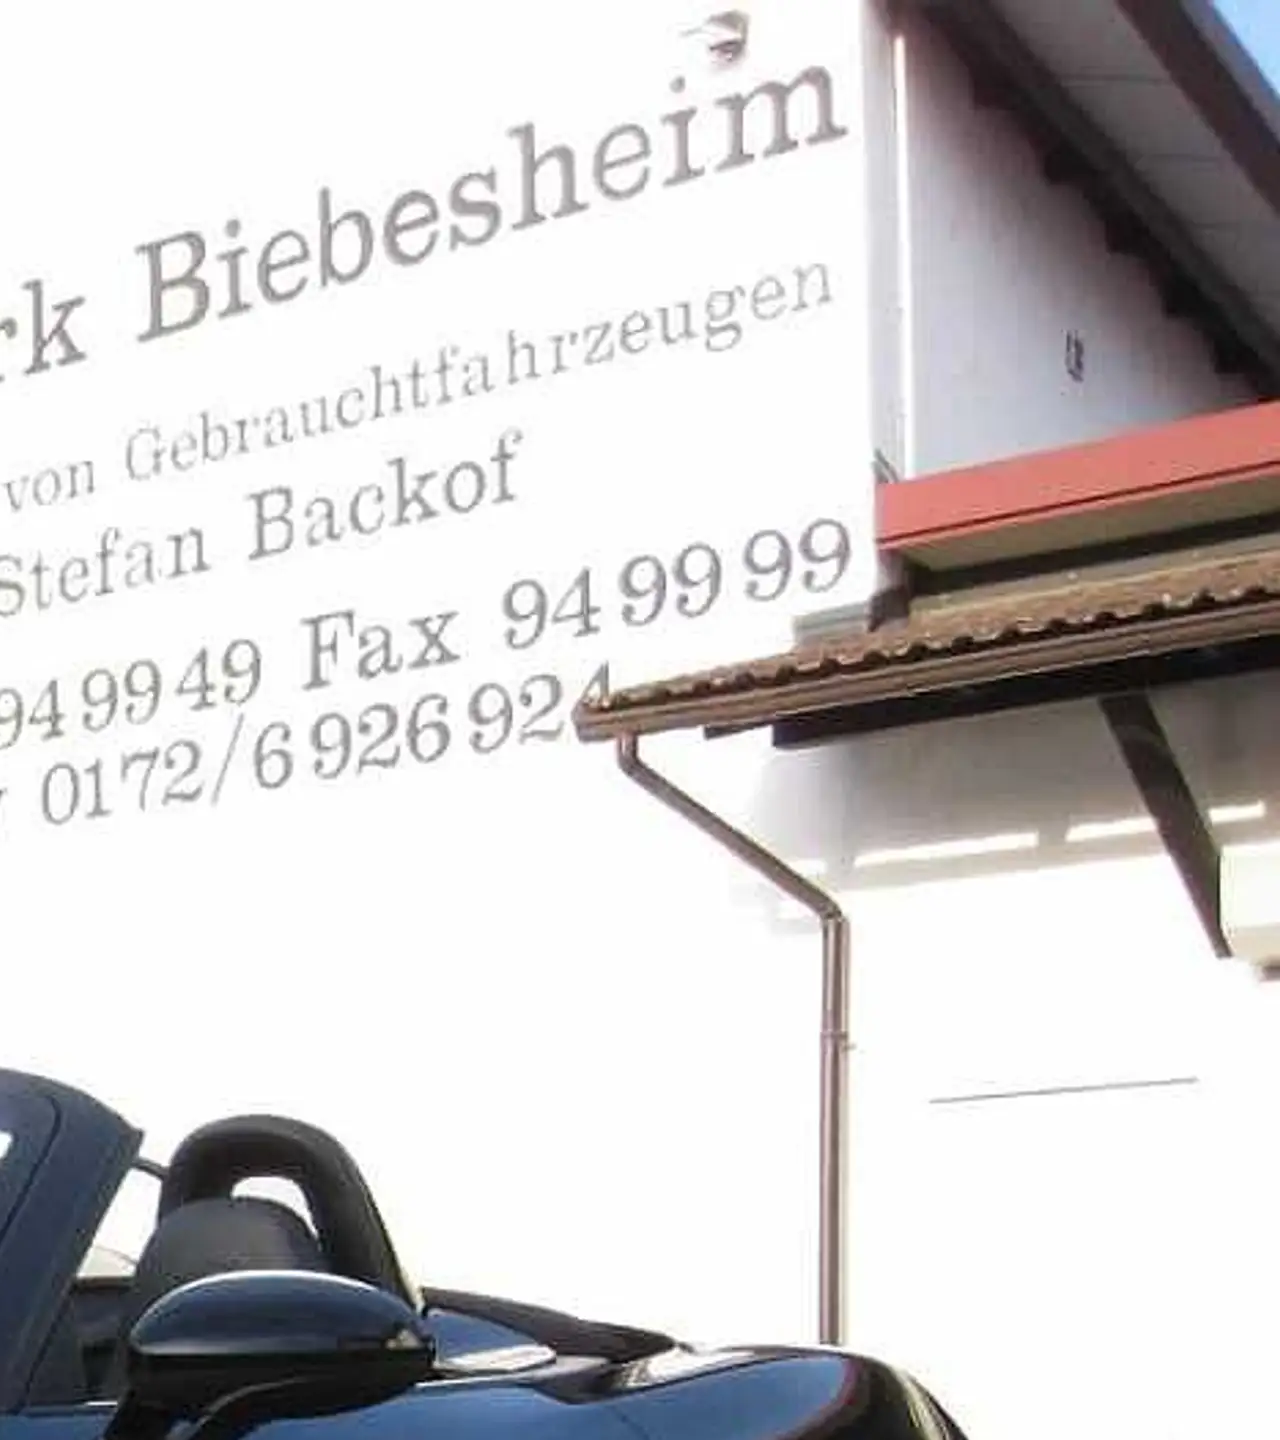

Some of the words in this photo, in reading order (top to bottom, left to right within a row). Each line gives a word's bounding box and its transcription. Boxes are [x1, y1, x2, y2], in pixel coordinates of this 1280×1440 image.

[135, 65, 848, 342] Biebesheim
[3, 459, 95, 512] von
[126, 262, 833, 481] Gebrauchtfahrzeugen
[245, 430, 523, 560] Backof
[300, 609, 460, 690] Fax
